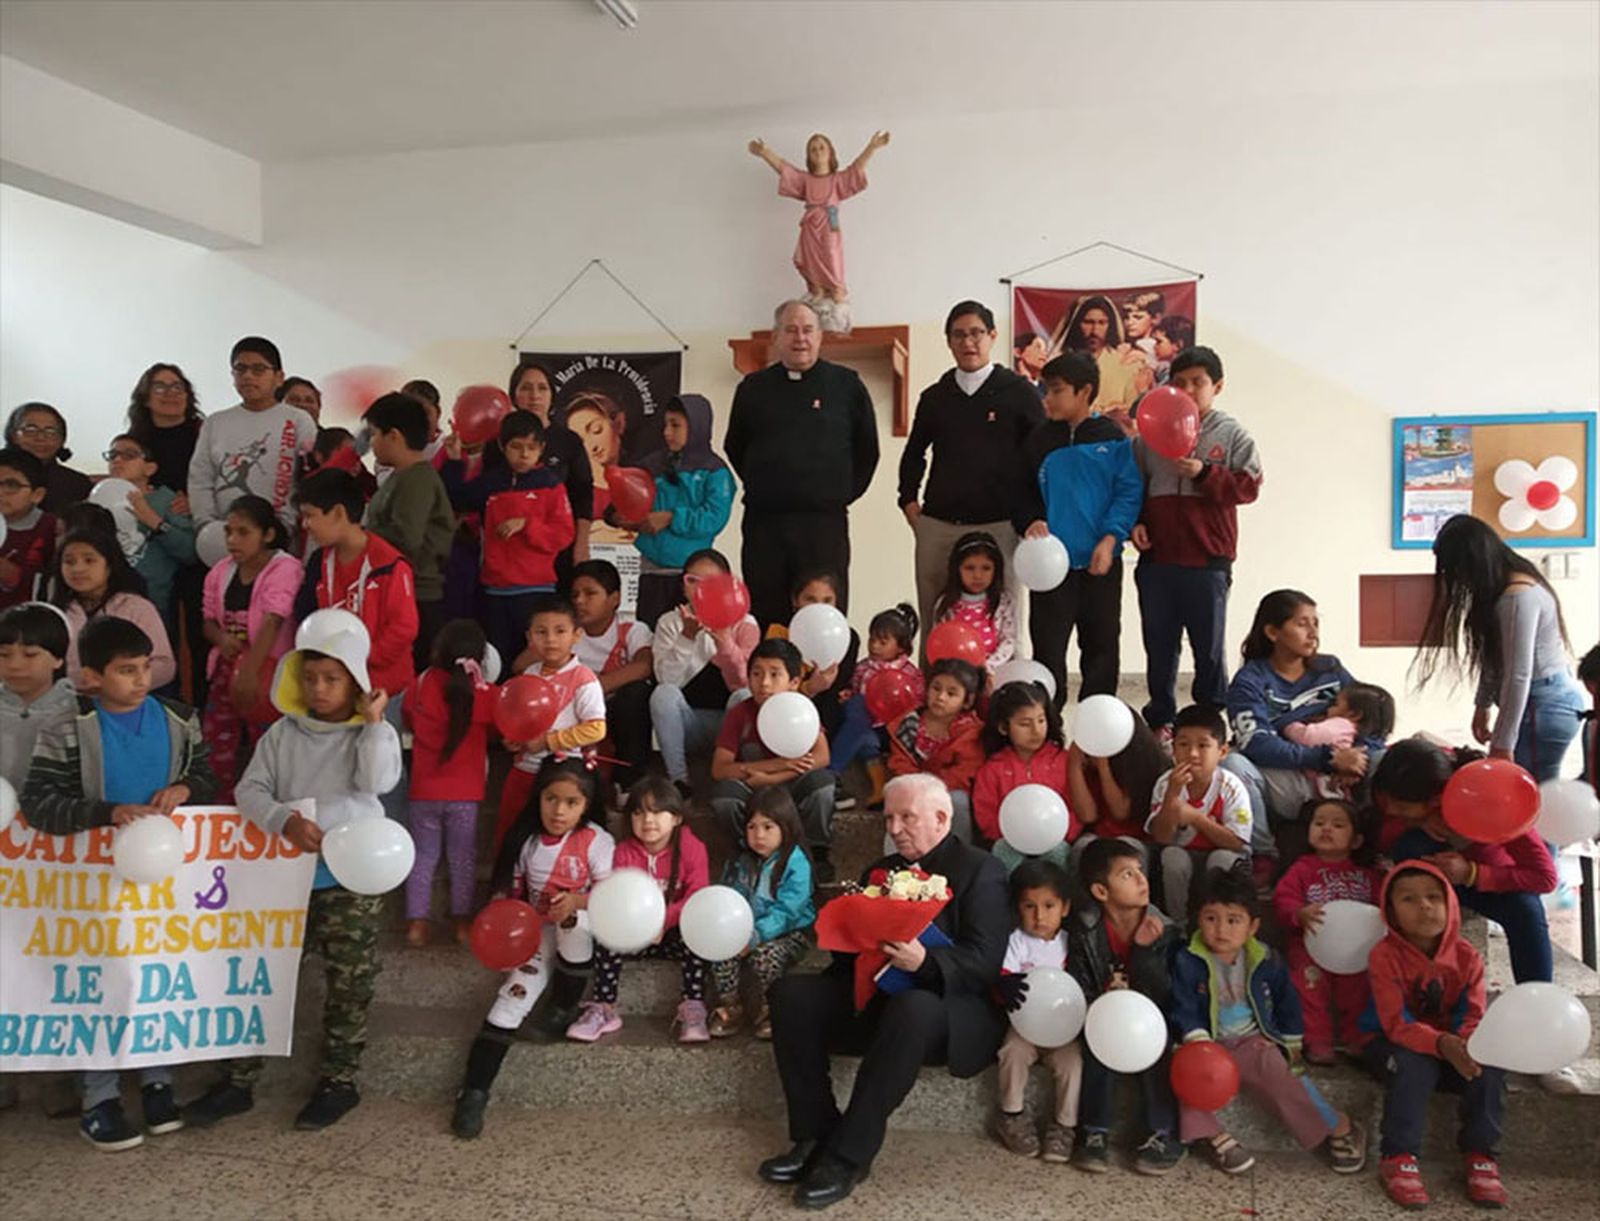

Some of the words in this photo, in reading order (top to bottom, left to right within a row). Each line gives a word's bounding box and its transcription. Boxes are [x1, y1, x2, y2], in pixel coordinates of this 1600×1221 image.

[584, 356, 599, 370] De
[602, 355, 616, 370] La
[0, 810, 302, 865] CATEUESI
[51, 963, 103, 1004] LE
[137, 961, 197, 1003] DA
[225, 956, 272, 996] LA
[0, 1004, 266, 1056] BIENVENIDA
